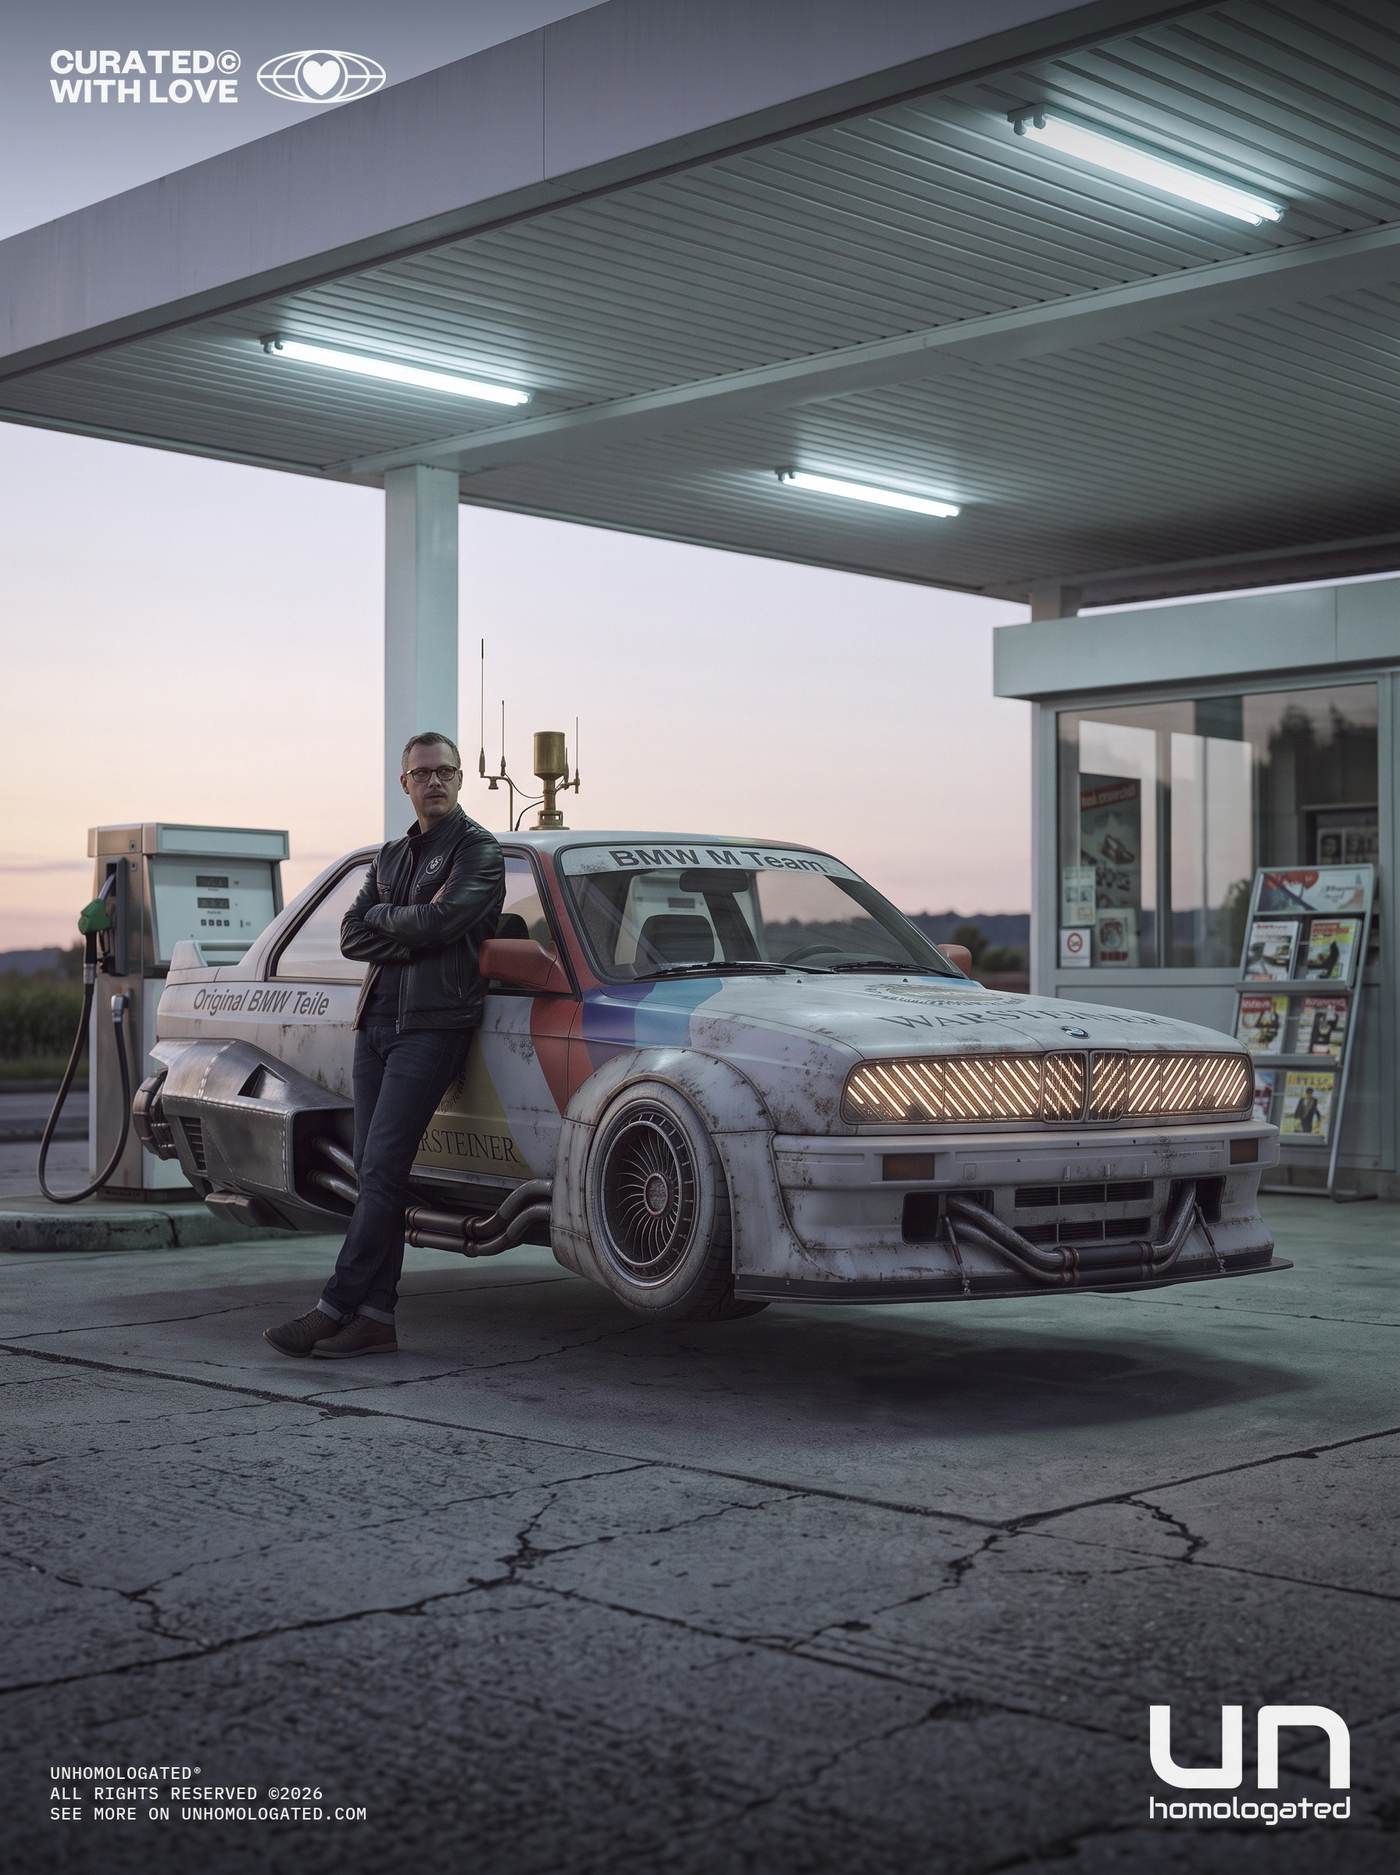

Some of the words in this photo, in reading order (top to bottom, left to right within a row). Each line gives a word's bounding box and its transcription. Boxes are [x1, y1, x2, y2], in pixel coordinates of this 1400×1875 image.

[608, 849, 700, 867] BMW
[705, 850, 741, 866] M
[740, 851, 828, 873] Team
[193, 988, 250, 1016] Original
[248, 990, 293, 1013] BMW
[292, 992, 330, 1016] Teile
[421, 1128, 519, 1162] RSTEINER
